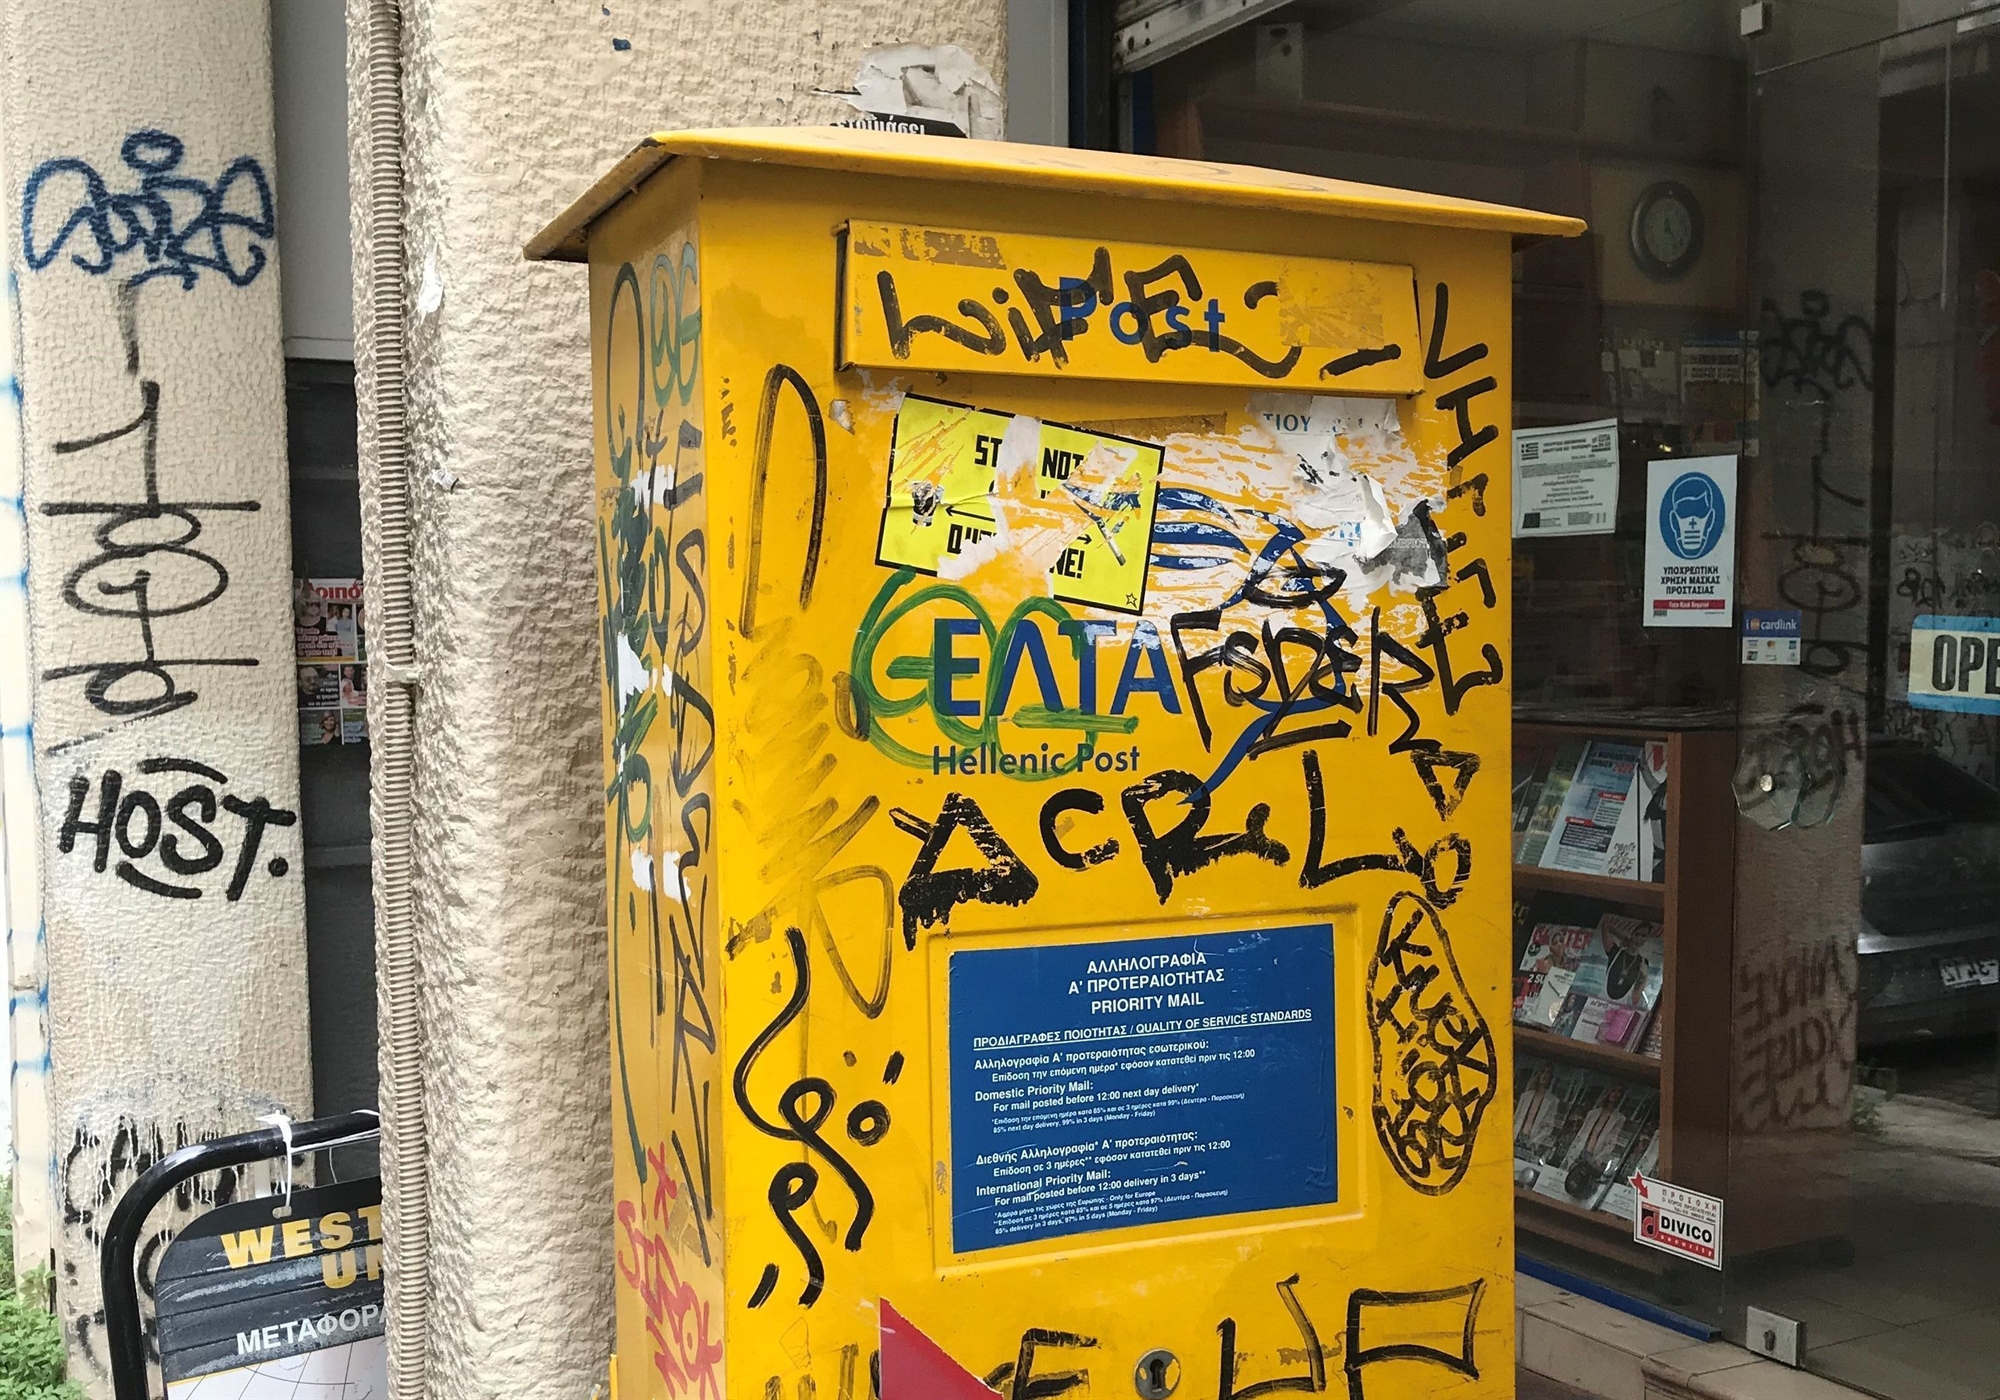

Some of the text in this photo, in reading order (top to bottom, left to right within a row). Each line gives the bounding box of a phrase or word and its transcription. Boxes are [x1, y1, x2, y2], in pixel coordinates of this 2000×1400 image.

[1059, 276, 1226, 353] Post
[1660, 575, 1721, 585] ΧΡΗΣΗ ΜΑΣΚΑΣ
[1663, 566, 1718, 575] ΥΠΟΧΡΕΩΤΙΚΗ
[1665, 586, 1715, 595] ΠΡΟΣΤΑΣΙΑΣ
[1760, 618, 1797, 630] cardlink
[932, 619, 1182, 716] ΕΛΤΑ
[932, 743, 1140, 776] Hellenic Post
[1087, 953, 1206, 974] ΑΛΛΗΛΟΓΡΑΦΙΑ
[1087, 969, 1225, 993] ΠΡΟΤΕΡΑΙΟΤΗΤΑΣ
[1091, 992, 1204, 1015] PRIORITY MAIL
[973, 1031, 1061, 1048] ΠΡΟΔΙΑΓΡΑΦΕΣ
[1064, 1025, 1127, 1041] ΠΟΙΟΤΗΤΑΣ
[1135, 1020, 1182, 1034] QUALITY
[1185, 1018, 1200, 1029] OF
[1202, 1013, 1248, 1028] SERVICE
[1250, 1008, 1312, 1023] STANDARDS
[974, 1054, 1050, 1070] Αλληλογραφία
[1065, 1046, 1146, 1063] προτεραιότητας
[1149, 1039, 1209, 1054] εσωτερικού:
[992, 1071, 1030, 1083] Επίδοση
[1032, 1070, 1048, 1081] την
[1049, 1065, 1087, 1080] επόμενη
[1120, 1058, 1154, 1071] εφόσον
[1155, 1054, 1197, 1067] κατατεθεί
[1198, 1053, 1217, 1064] πριν
[1218, 1052, 1231, 1062] τις
[1232, 1048, 1256, 1060] 12:00
[974, 1080, 1094, 1102] Domestic Priority Mail:
[993, 1103, 1009, 1113] For
[1010, 1100, 1031, 1111] mail
[1032, 1097, 1064, 1110] posted
[1065, 1094, 1095, 1105] before
[1097, 1090, 1121, 1102] 12:00
[1122, 1089, 1142, 1099] next
[1143, 1087, 1160, 1098] day
[1007, 1124, 1021, 1132] next
[1022, 1123, 1034, 1131] day
[1062, 1118, 1075, 1126] 99%
[1088, 1115, 1103, 1123] days
[976, 1151, 1018, 1165] Διεθνής
[1115, 1131, 1198, 1149] προτεραιότητας:
[993, 1166, 1031, 1177] Επίδοση
[1033, 1163, 1044, 1172] σε
[1046, 1161, 1052, 1170] 3
[1094, 1151, 1128, 1164] εφόσον
[1129, 1146, 1172, 1160] κατατεθεί
[1173, 1144, 1192, 1155] πριν
[1193, 1144, 1206, 1153] τις
[1207, 1139, 1231, 1150] 12:00
[976, 1169, 1112, 1196] International Priority Mail:
[994, 1196, 1010, 1206] For
[1011, 1194, 1031, 1204] mail
[1033, 1189, 1065, 1202] posted
[1066, 1185, 1096, 1196] before
[1097, 1180, 1121, 1191] 12:00
[1123, 1175, 1159, 1188] delivery
[1160, 1174, 1169, 1183] in
[1170, 1173, 1177, 1182] 3
[1109, 1193, 1124, 1202] Only
[1124, 1192, 1134, 1200] for
[1134, 1190, 1156, 1199] Europe
[1091, 1211, 1106, 1220] days
[1661, 1215, 1712, 1243] DIVICO
